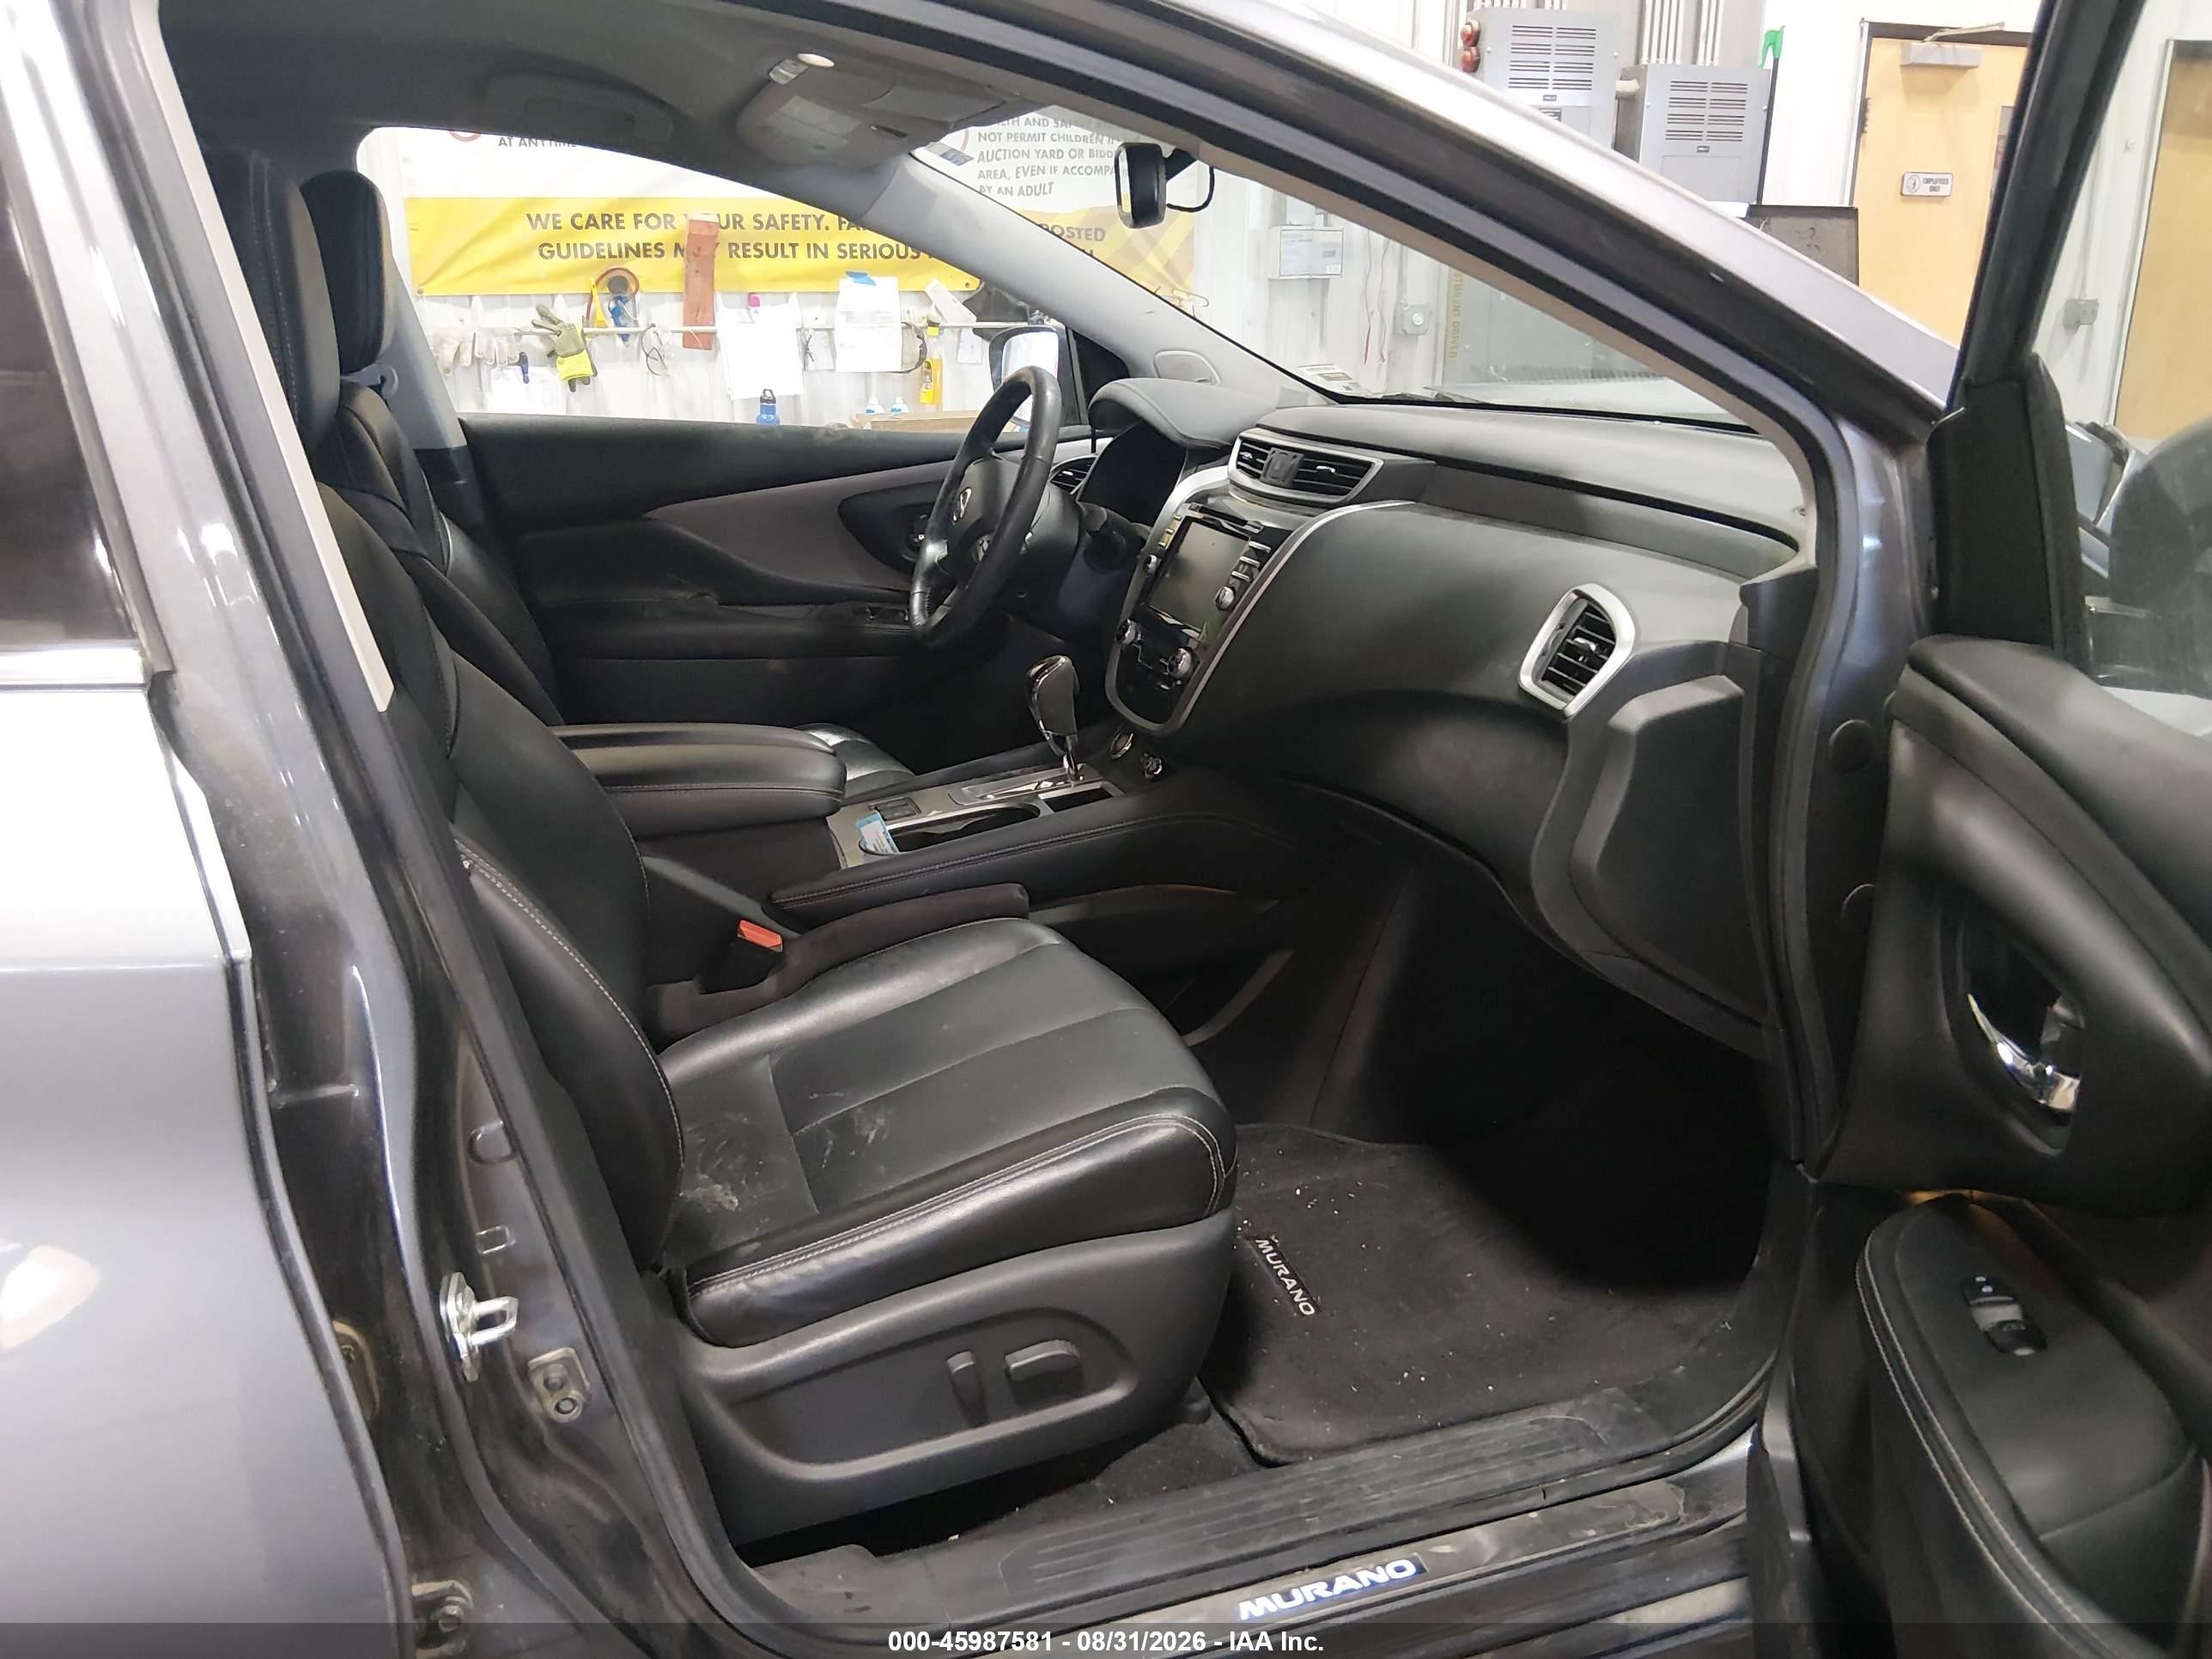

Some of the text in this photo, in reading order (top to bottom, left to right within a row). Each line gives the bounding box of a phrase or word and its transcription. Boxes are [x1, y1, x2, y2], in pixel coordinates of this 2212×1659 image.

[1024, 117, 1049, 128] AND
[498, 137, 514, 147] AT
[977, 132, 1003, 143] NOT
[1006, 132, 1047, 143] PERMIT
[1050, 133, 1103, 145] CHILDREN
[977, 148, 1114, 164] AUCTION YARD OR BIDD
[977, 168, 1011, 181] AREA,
[1015, 165, 1046, 179] EVEN
[1049, 166, 1058, 174] IF
[979, 181, 1054, 197] BY AN ADULT
[526, 213, 562, 230] WE
[570, 213, 626, 230] CARE
[633, 213, 677, 230] FOR
[753, 213, 830, 231] SAFETY.
[538, 242, 665, 259] GUIDELINES
[728, 242, 799, 259] RESULT
[807, 243, 828, 259] IN
[1255, 1239, 1316, 1316] MURANO
[1238, 1559, 1417, 1620] MURANO
